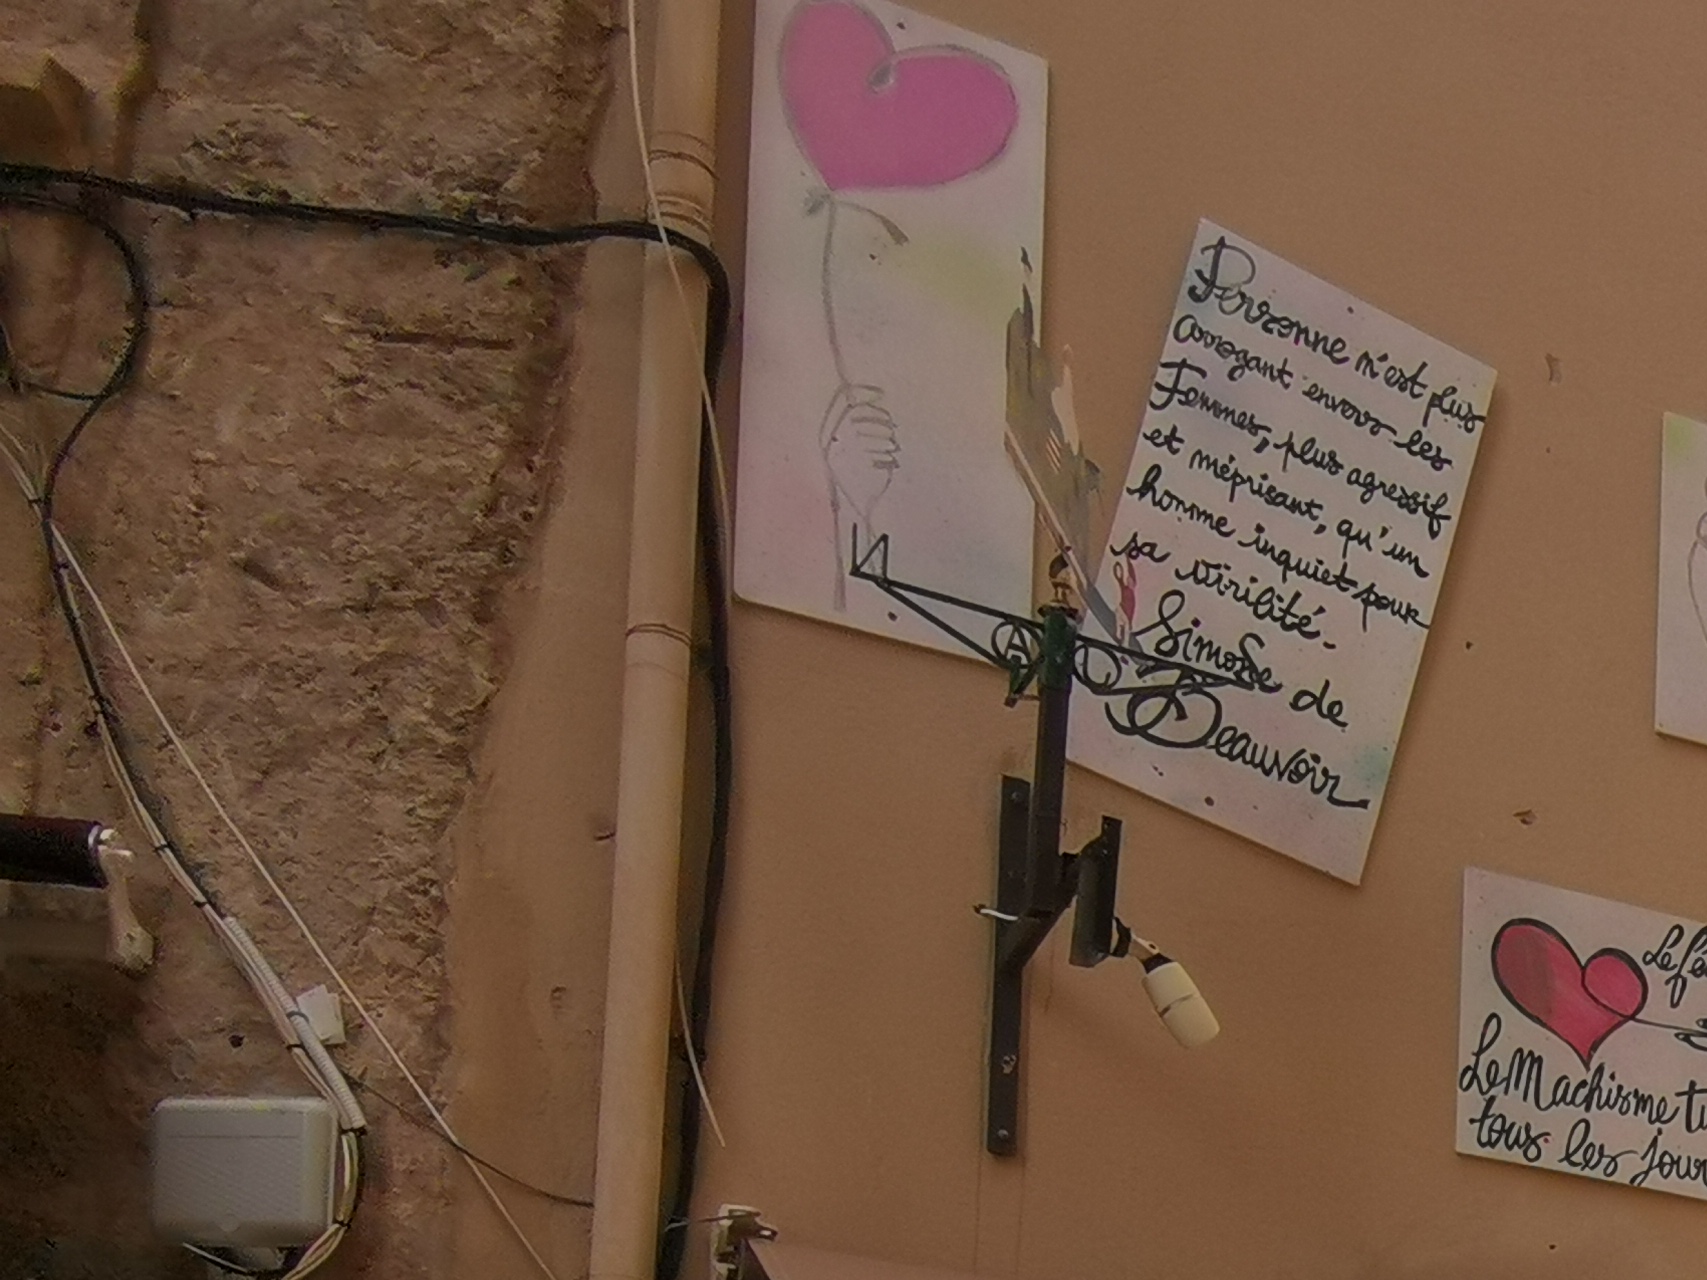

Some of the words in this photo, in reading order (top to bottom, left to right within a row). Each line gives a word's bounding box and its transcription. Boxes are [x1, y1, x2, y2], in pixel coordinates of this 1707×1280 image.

[1171, 313, 1295, 388] arrogant
[1301, 380, 1397, 444] envers
[1394, 421, 1453, 473] les
[1188, 235, 1350, 366] Personne
[1354, 347, 1427, 400] n'est
[1423, 376, 1486, 433] plus
[1143, 426, 1185, 457] et
[1335, 515, 1430, 581] qu'un
[1272, 422, 1345, 478] plus
[1346, 461, 1453, 540] agressif
[1110, 533, 1170, 569] sa
[1127, 464, 1236, 540] homme
[1239, 521, 1359, 594] inquiet
[1352, 581, 1431, 634] pour
[1135, 589, 1283, 696] Simone
[1290, 672, 1350, 729] de
[1104, 689, 1371, 811] Beauvoir
[1643, 924, 1676, 971] Le
[1460, 1012, 1507, 1094] Le
[1501, 1046, 1680, 1126] Machisme
[1470, 1092, 1550, 1162] tous
[1559, 1118, 1637, 1179] les
